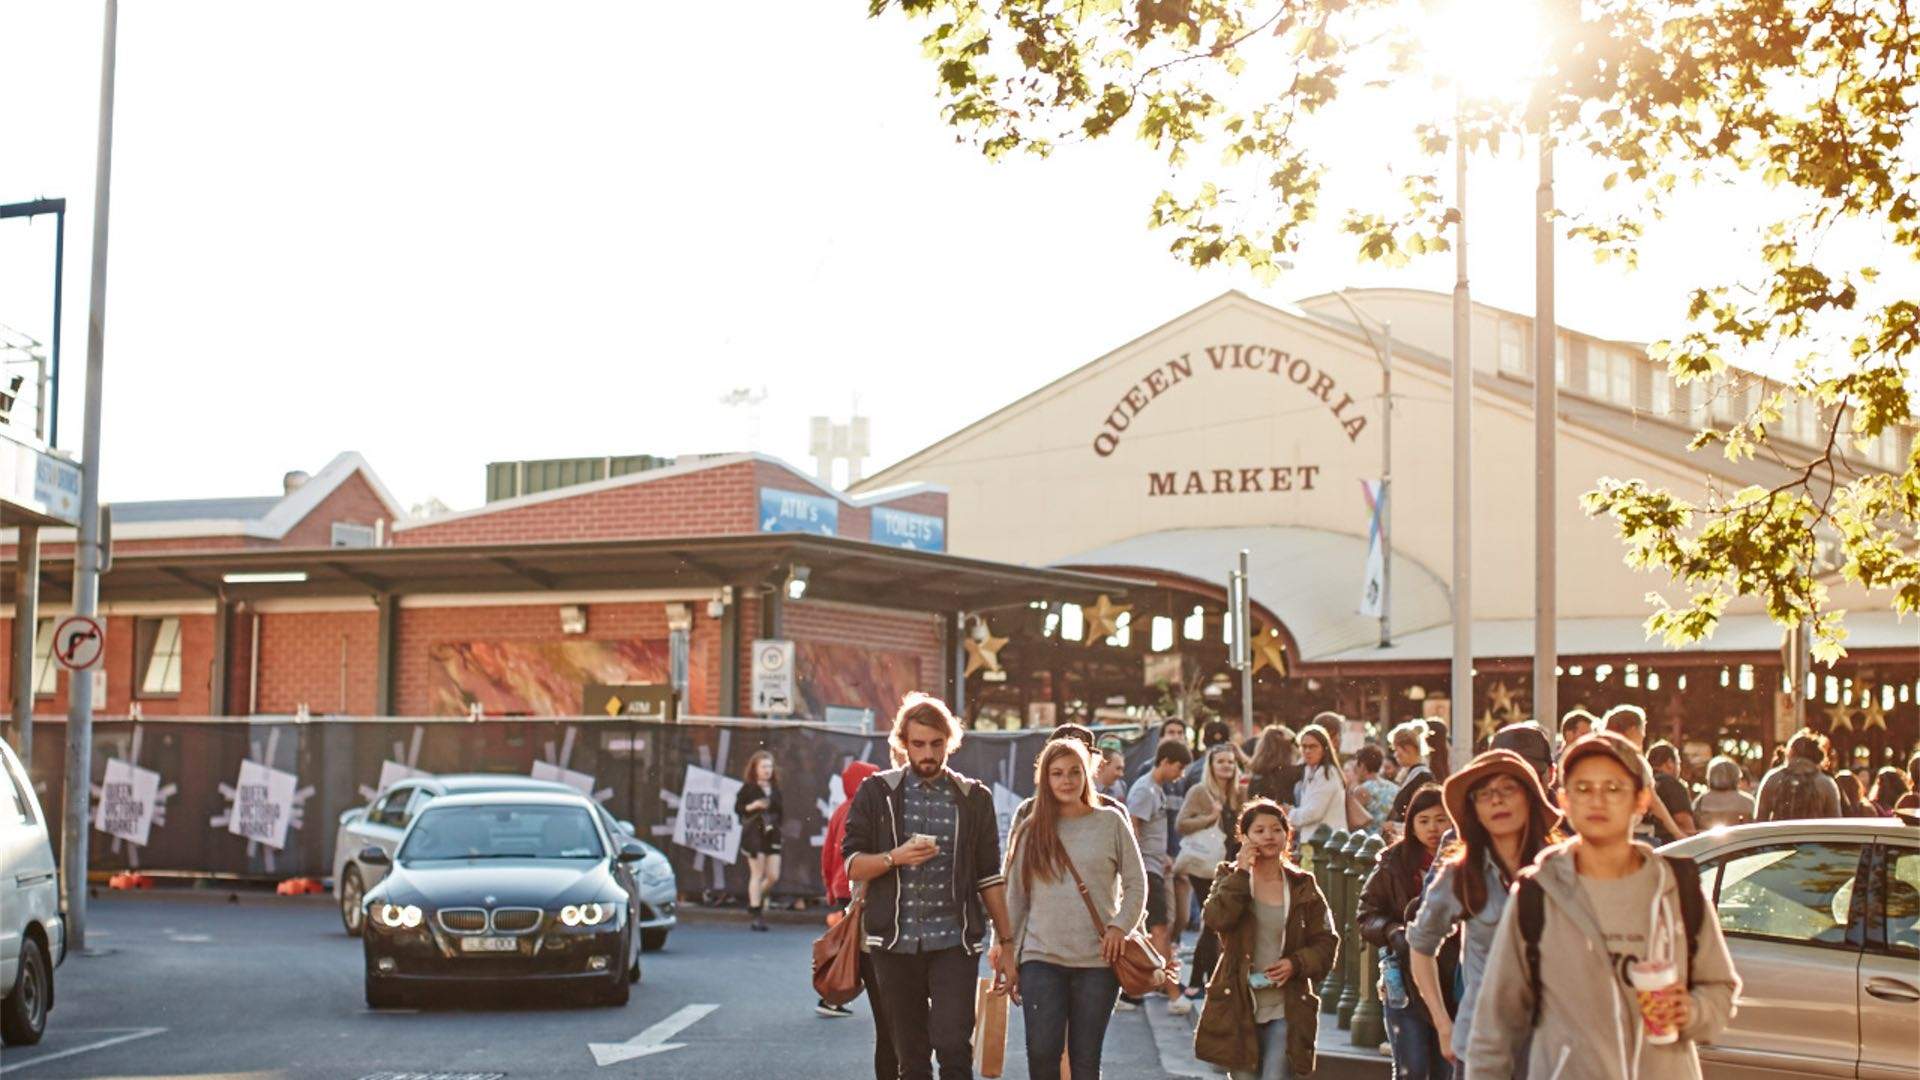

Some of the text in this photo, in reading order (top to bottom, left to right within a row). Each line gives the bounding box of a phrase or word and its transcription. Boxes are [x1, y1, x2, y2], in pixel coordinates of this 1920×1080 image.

[1093, 344, 1368, 458] QUEEN VICTORIA
[1148, 465, 1320, 497] MARKET
[884, 513, 934, 541] TOILETS
[627, 701, 652, 714] ATM
[105, 783, 133, 801] QUEEN
[240, 784, 269, 802] QUEEN
[685, 791, 720, 812] QUEEN
[104, 800, 145, 819] VICTORIA
[239, 802, 281, 820] VICTORIA
[104, 817, 139, 836] MARKET
[239, 820, 276, 839] MARKET
[684, 811, 733, 832] VICTORIA
[684, 831, 727, 852] MARKET
